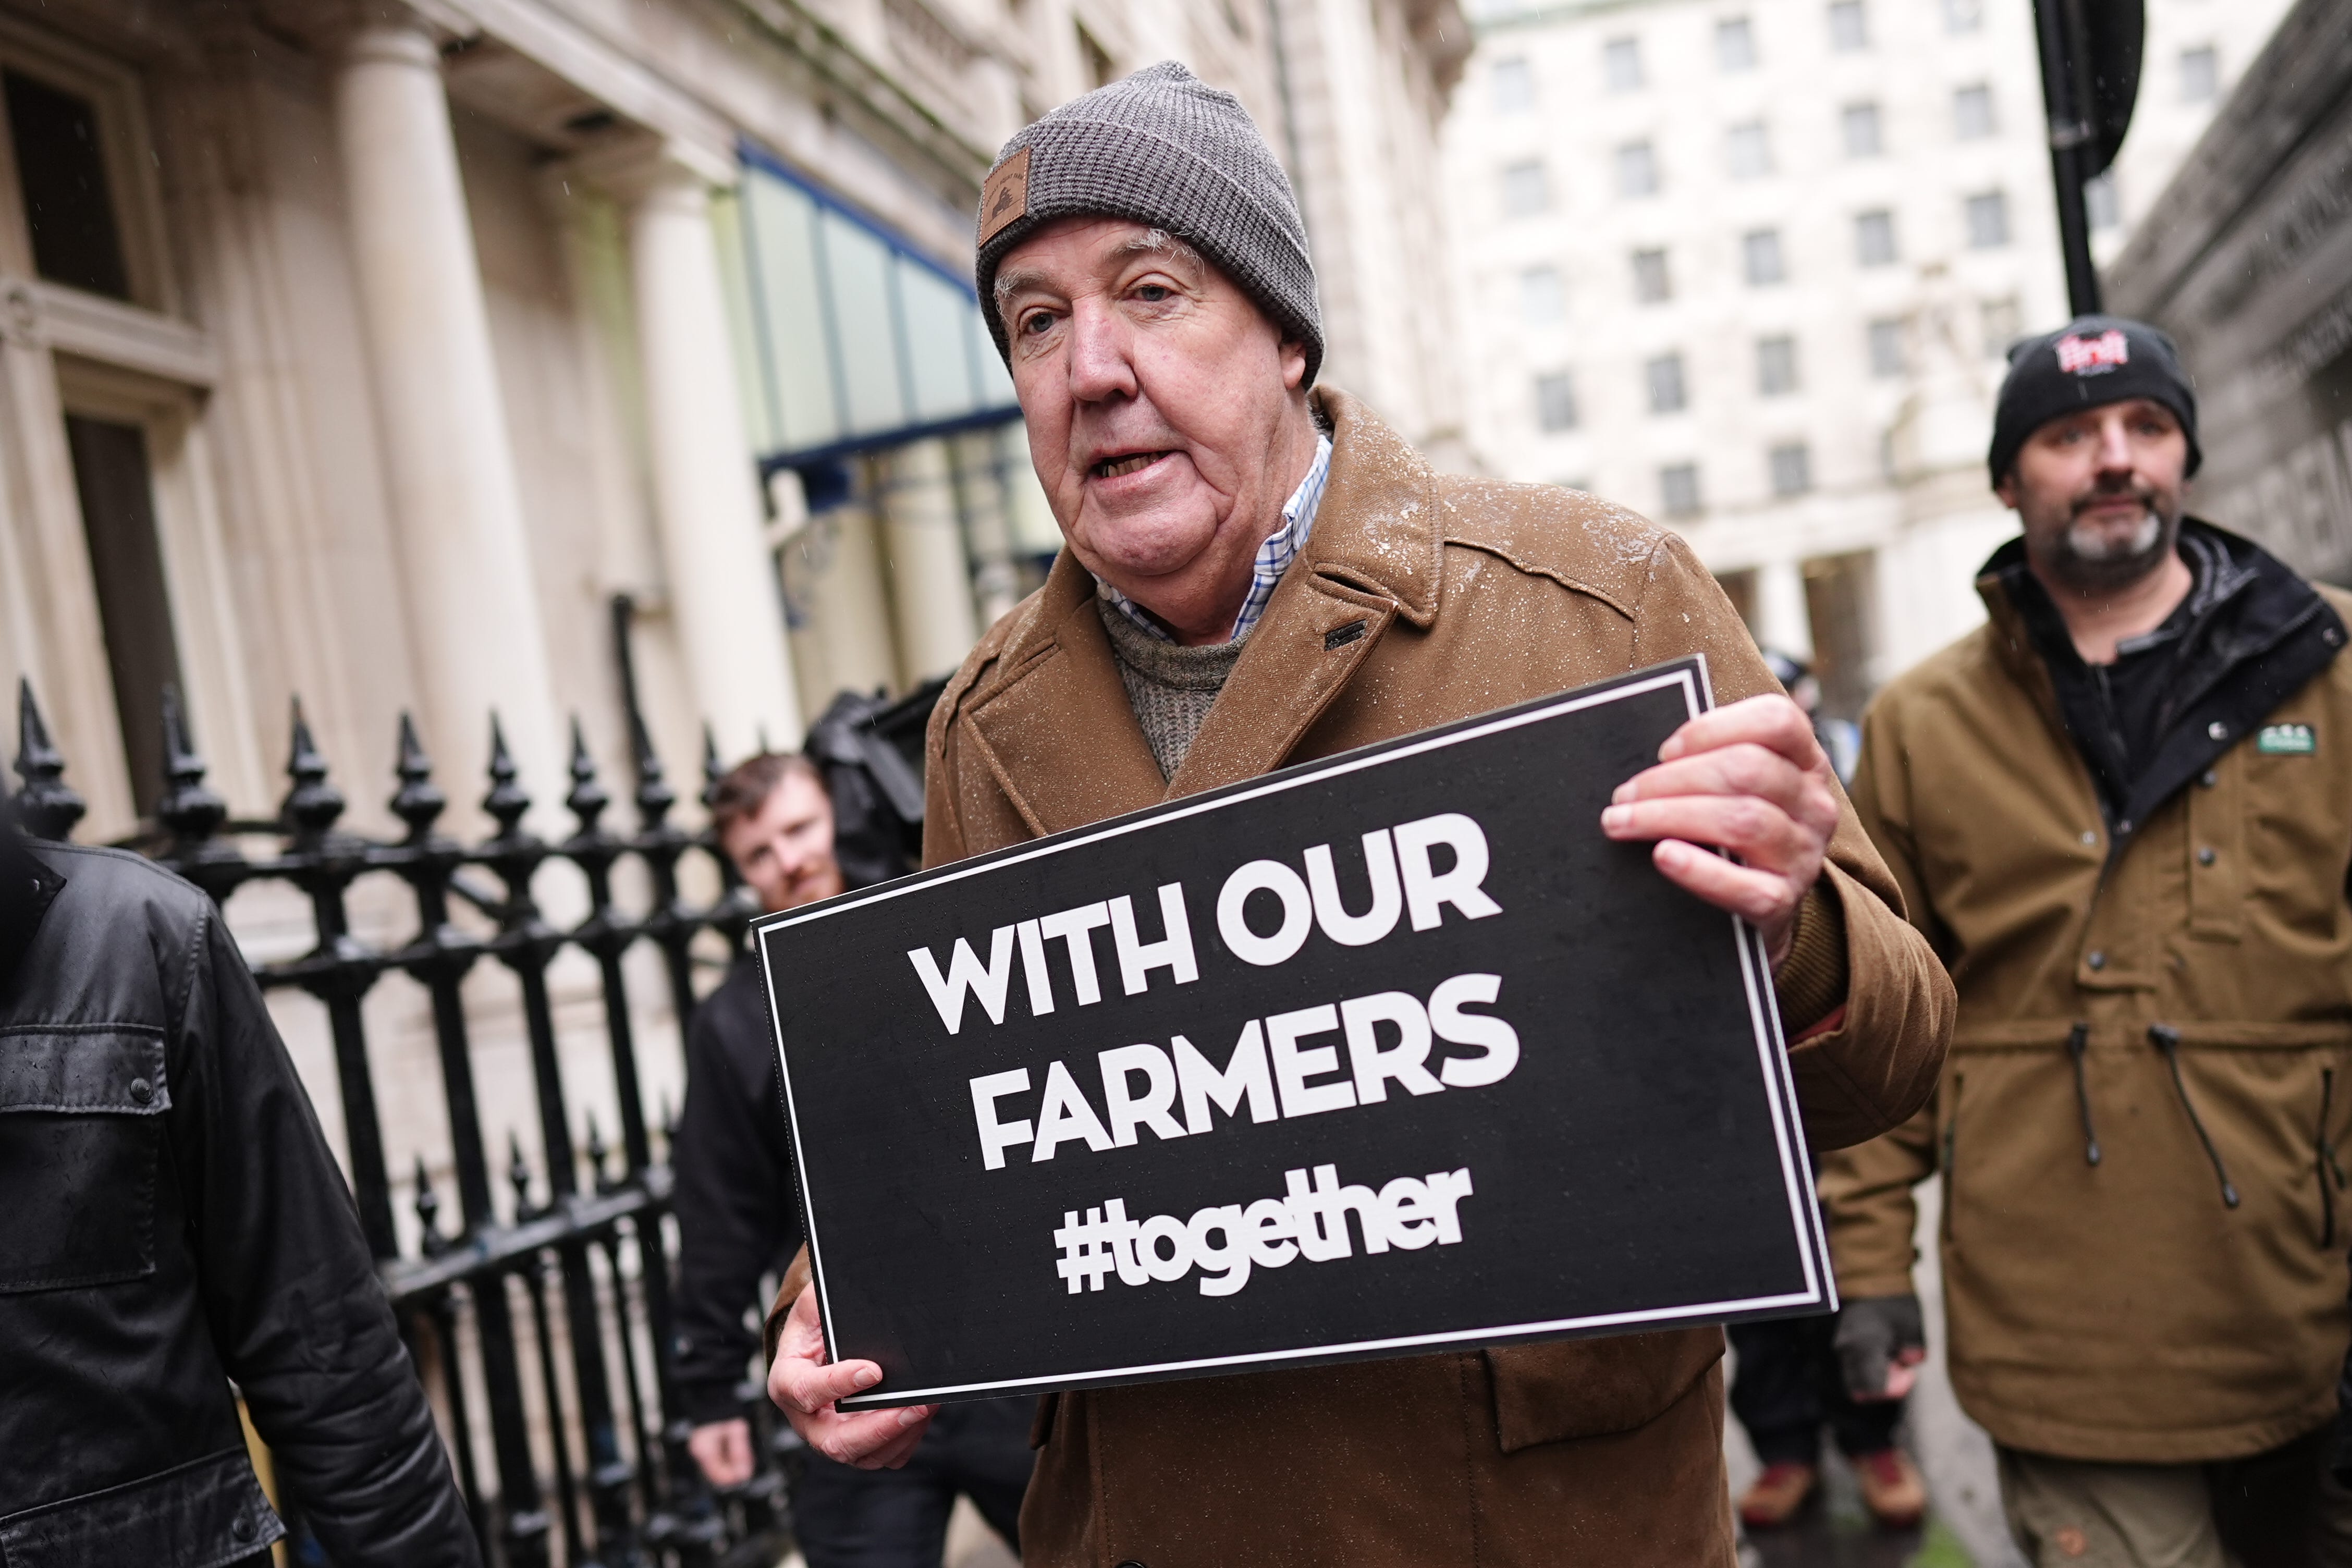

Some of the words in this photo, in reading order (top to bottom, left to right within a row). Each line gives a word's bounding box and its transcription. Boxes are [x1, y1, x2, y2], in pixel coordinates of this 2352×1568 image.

[907, 881, 1199, 1035] WITH
[1217, 813, 1503, 966] OUR
[969, 973, 1520, 1171] FARMERS
[1053, 1163, 1473, 1296] #together
